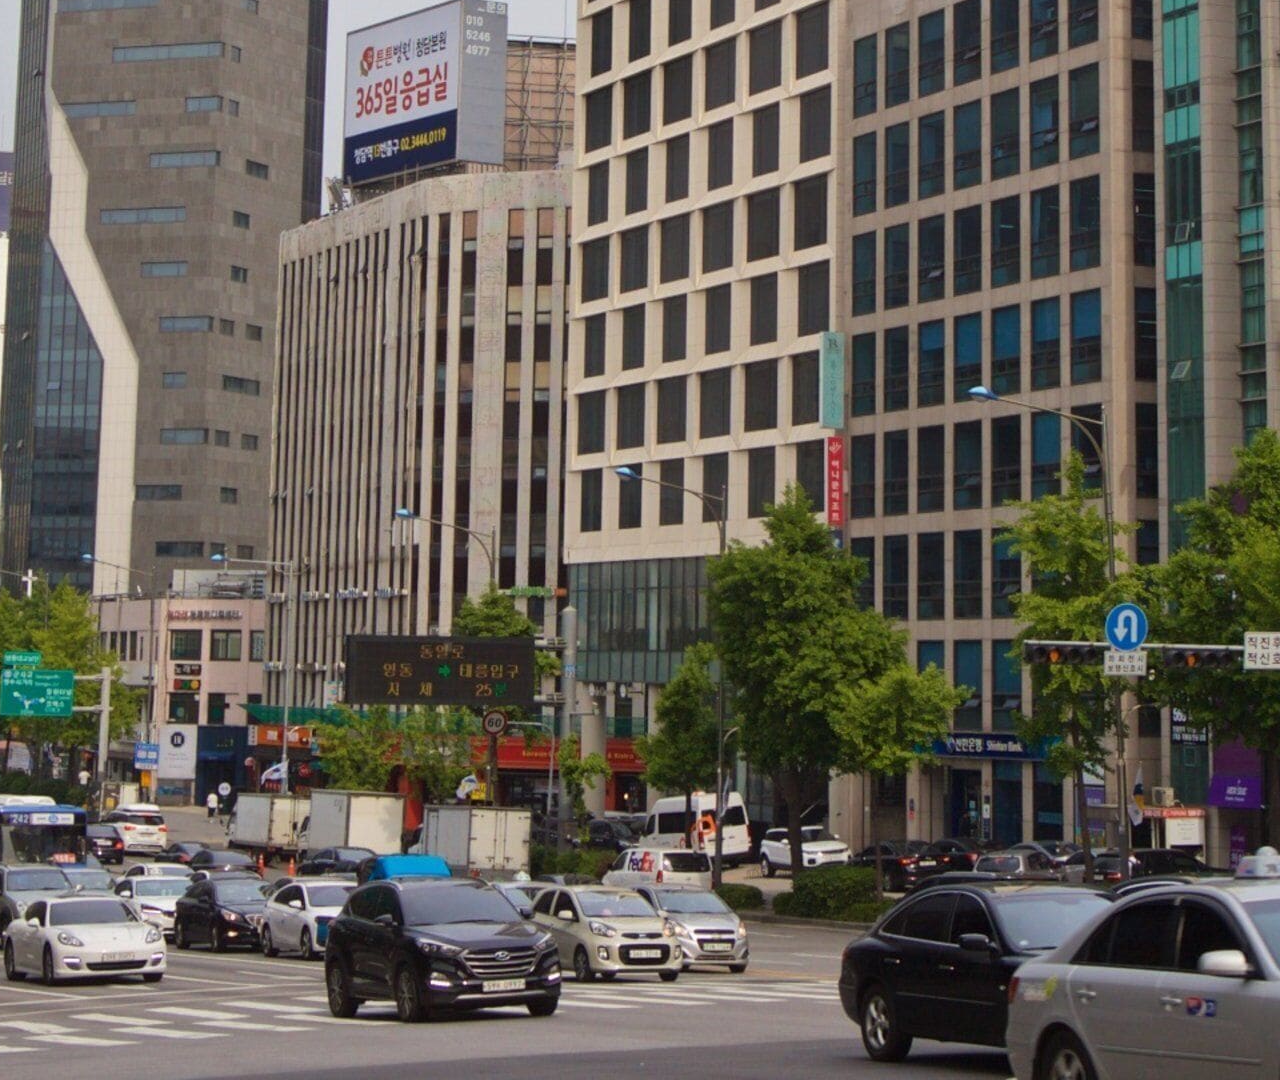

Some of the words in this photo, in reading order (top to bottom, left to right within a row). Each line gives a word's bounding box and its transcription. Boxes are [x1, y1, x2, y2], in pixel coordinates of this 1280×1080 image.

[465, 15, 484, 27] 010
[375, 38, 411, 69] 튼튼병원
[355, 62, 449, 118] 365일응급실
[628, 851, 654, 872] FedEx
